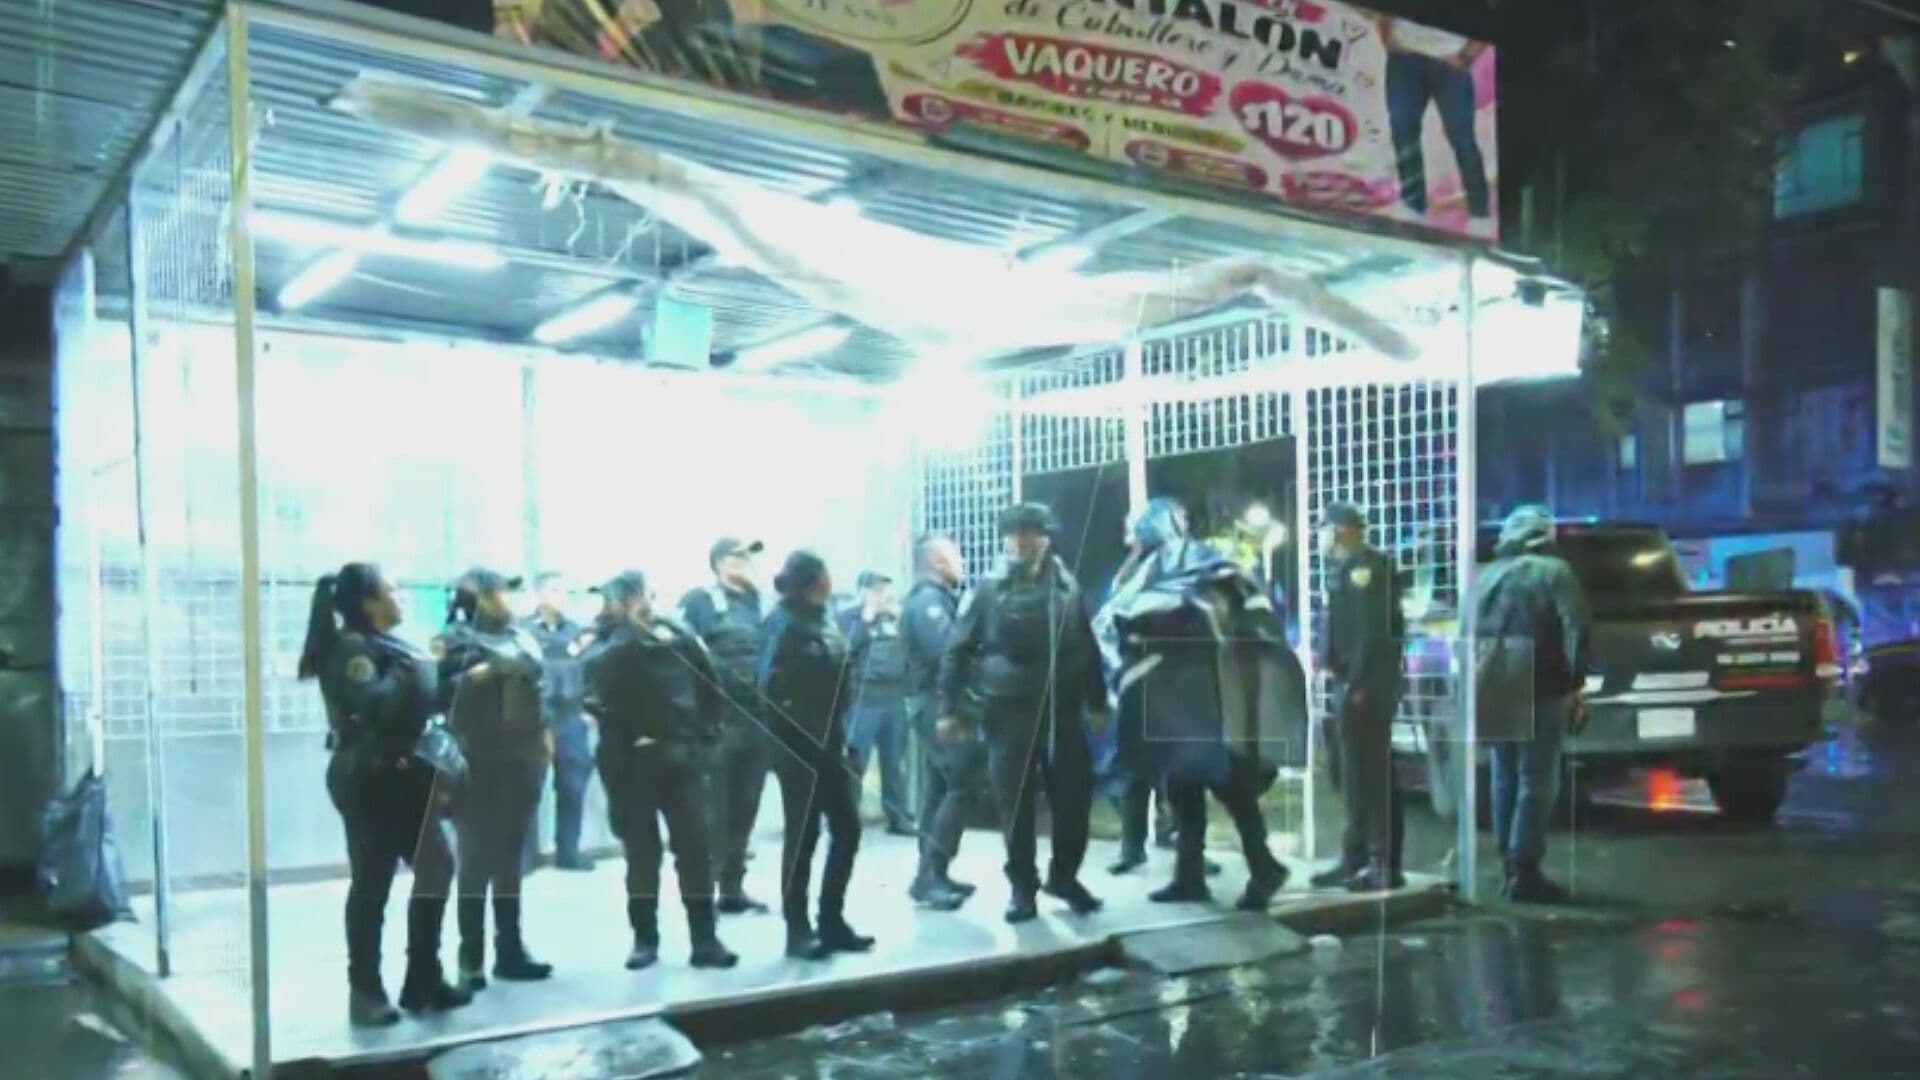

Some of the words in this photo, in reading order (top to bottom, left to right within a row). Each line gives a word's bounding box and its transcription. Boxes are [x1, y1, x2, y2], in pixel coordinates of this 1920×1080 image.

[1004, 37, 1201, 97] VAQUERO
[1241, 99, 1346, 151] $120
[1693, 612, 1798, 640] POLICÍA
